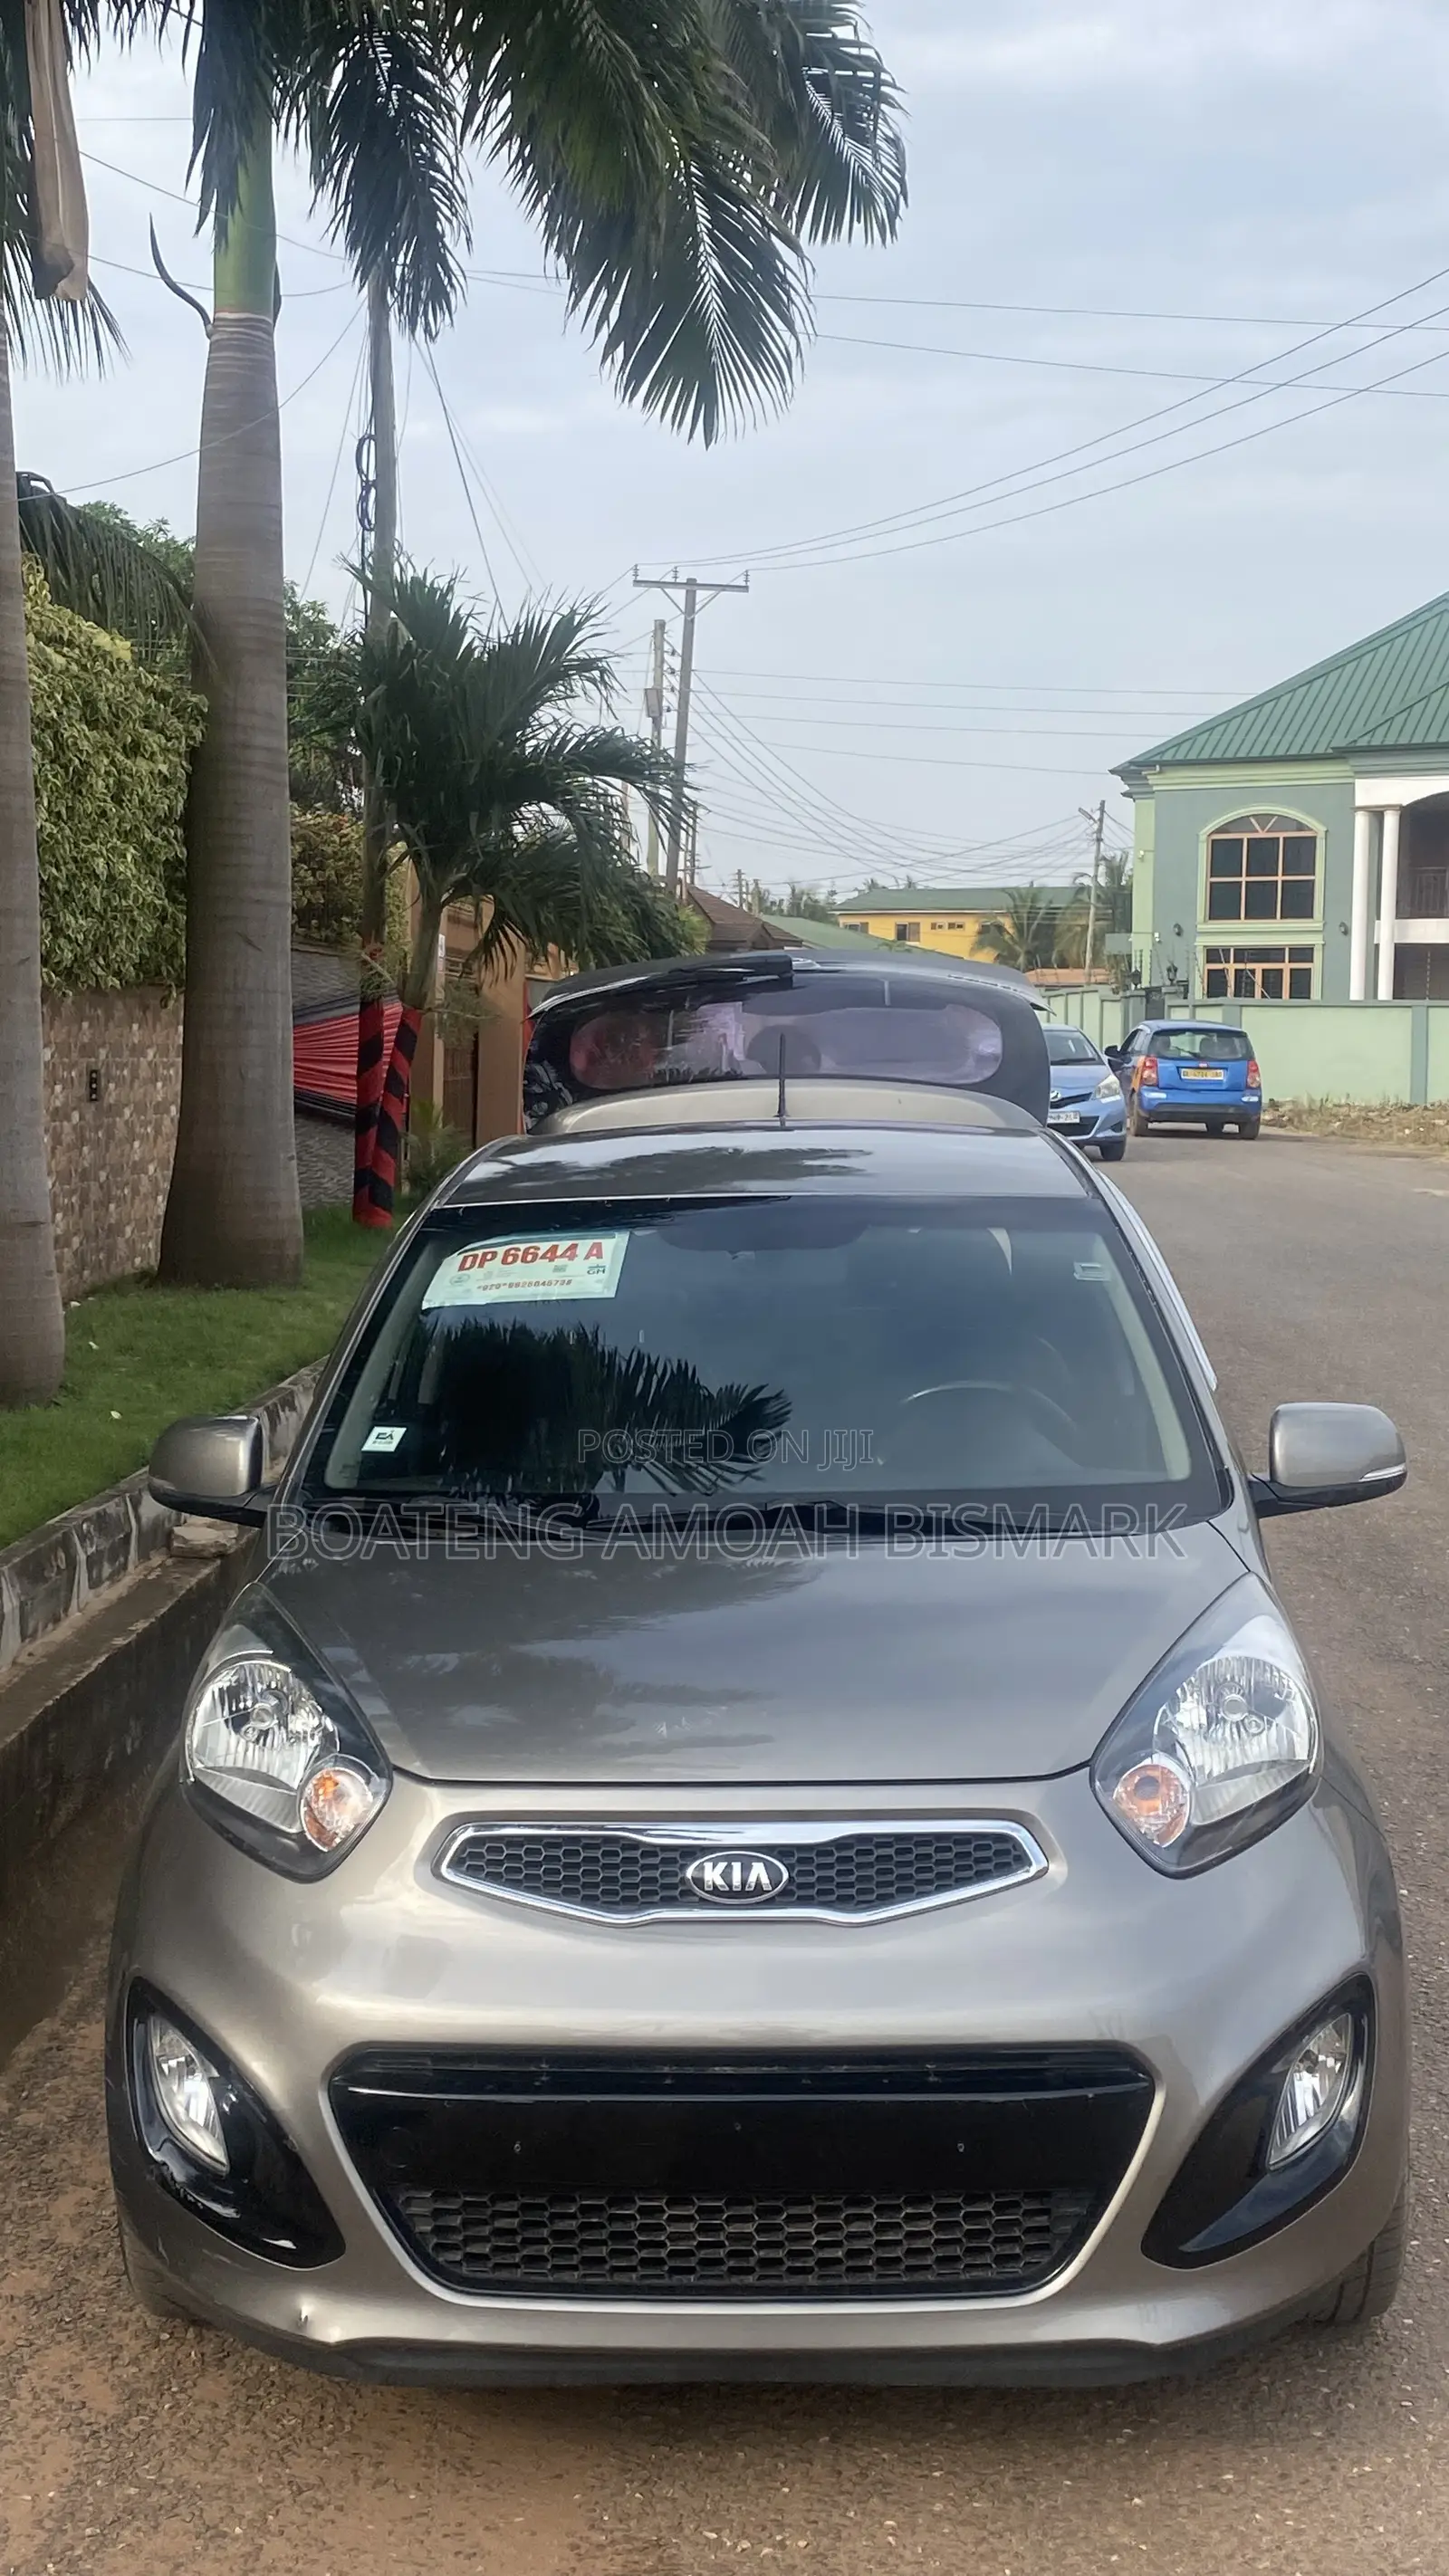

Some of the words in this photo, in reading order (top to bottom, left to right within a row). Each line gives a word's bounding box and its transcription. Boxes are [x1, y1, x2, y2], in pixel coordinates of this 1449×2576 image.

[458, 1251, 498, 1272] DP
[501, 1242, 580, 1265] 6644
[583, 1241, 604, 1260] A
[703, 1862, 772, 1891] KIA
